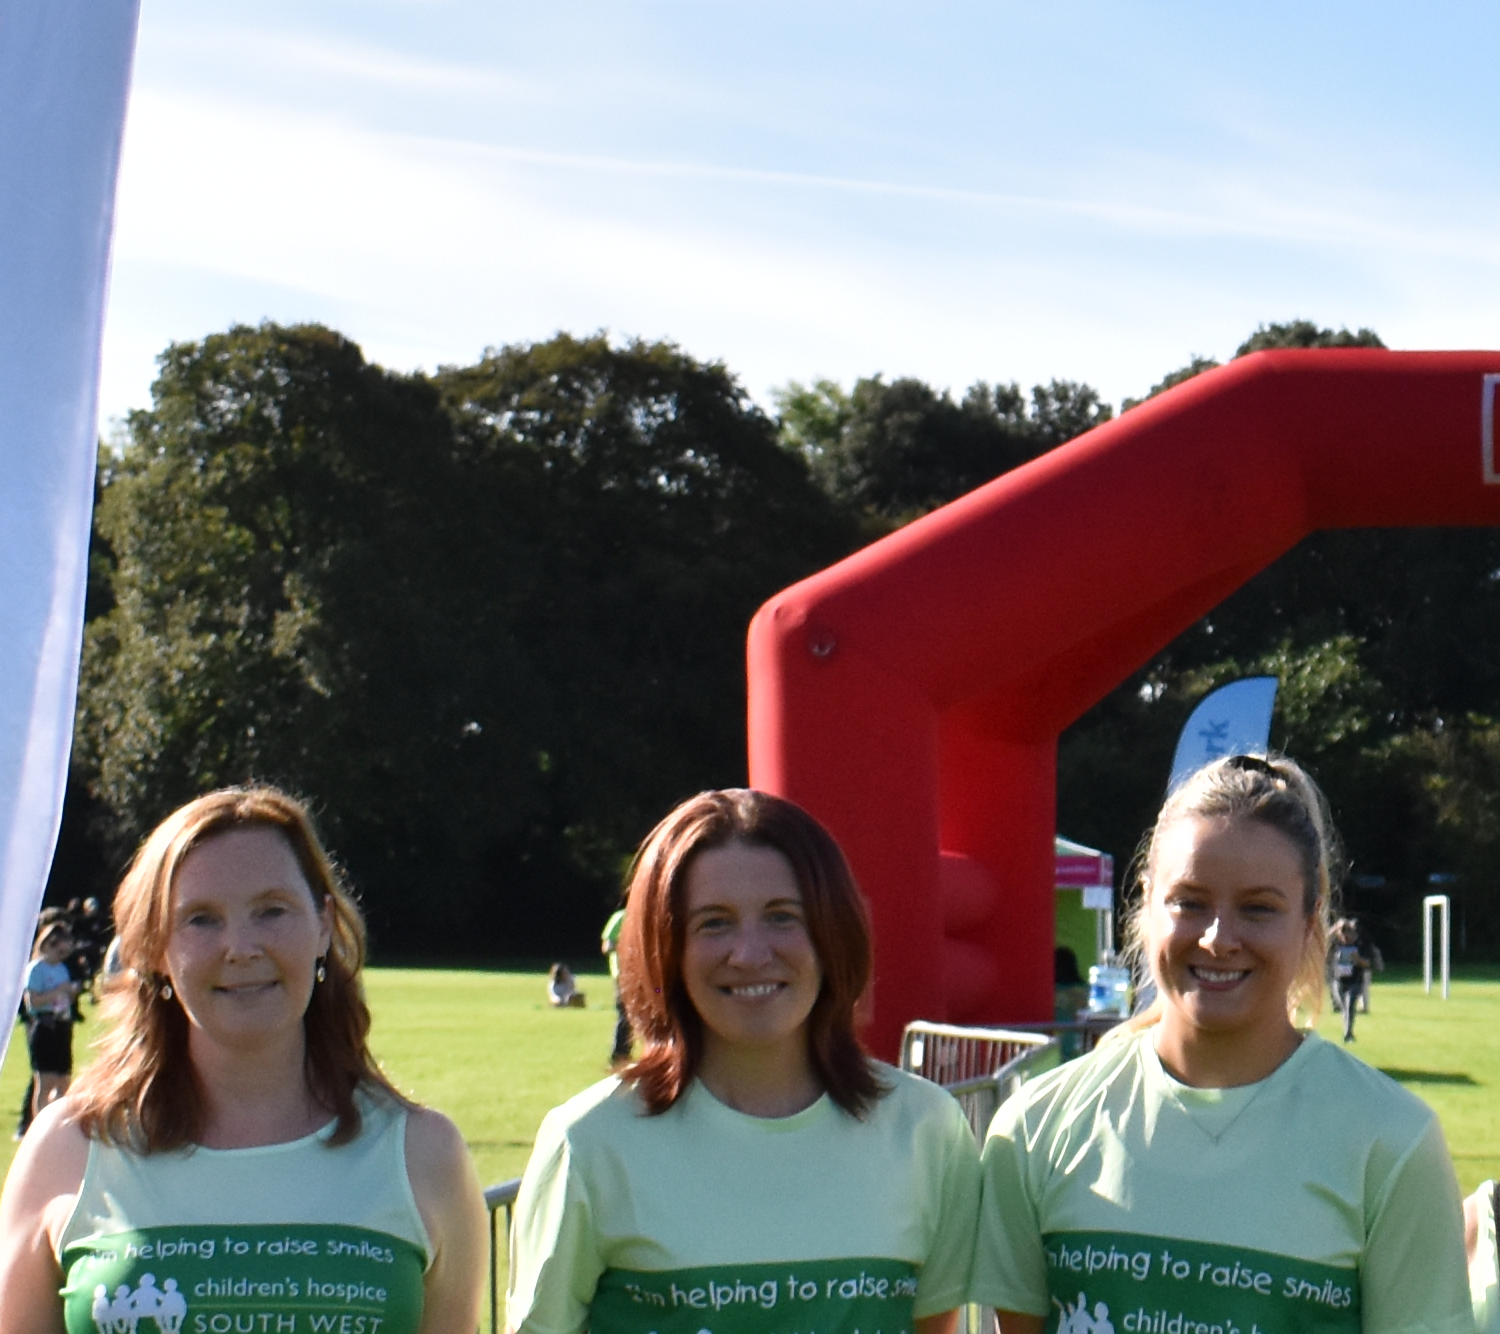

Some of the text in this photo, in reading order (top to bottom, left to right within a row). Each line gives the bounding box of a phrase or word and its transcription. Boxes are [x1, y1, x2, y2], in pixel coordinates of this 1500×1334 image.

[125, 1237, 216, 1261] helping
[223, 1236, 250, 1256] to
[257, 1237, 319, 1256] raise
[326, 1238, 395, 1264] smiles
[193, 1276, 388, 1302] children's hospice
[1060, 1243, 1152, 1282] helping
[1160, 1250, 1191, 1279] to
[1199, 1261, 1273, 1295] raise
[1282, 1275, 1353, 1309] smiles
[671, 1279, 778, 1311] helping
[787, 1274, 818, 1300] to
[826, 1270, 890, 1299] raise
[194, 1313, 296, 1334] SOUTH
